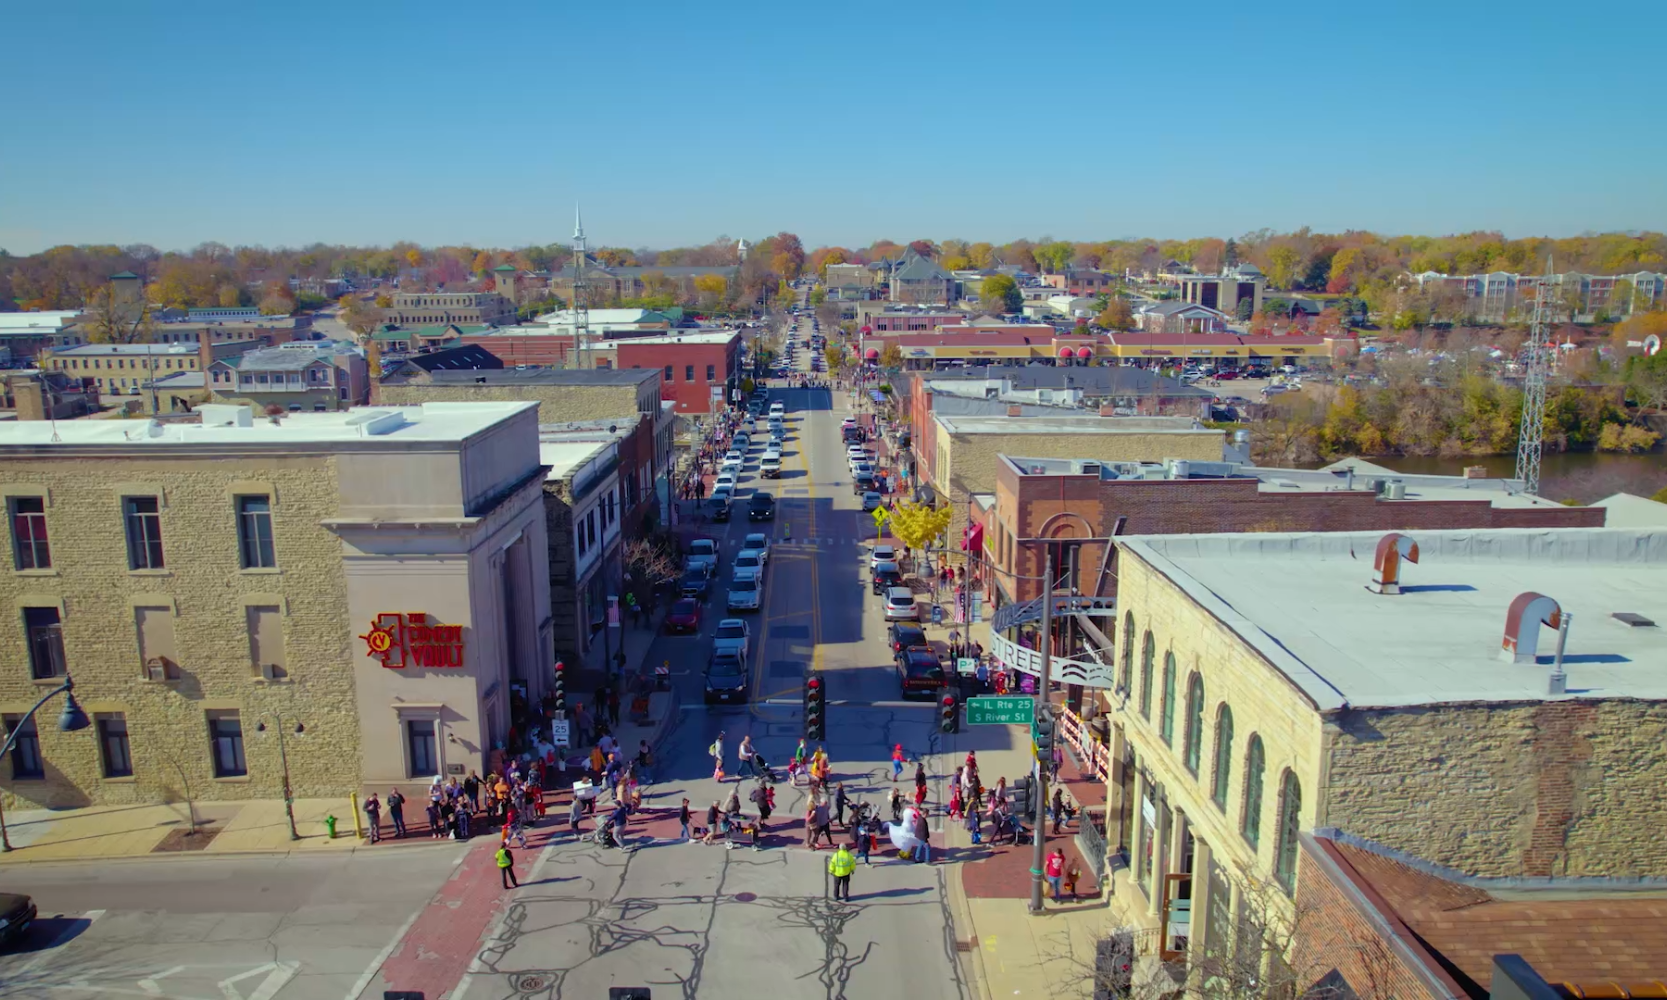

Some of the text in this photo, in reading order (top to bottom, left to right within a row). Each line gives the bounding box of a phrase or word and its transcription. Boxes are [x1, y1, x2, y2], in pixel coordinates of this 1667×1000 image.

[408, 624, 463, 643] COMEDY
[410, 644, 463, 668] VAULT
[984, 701, 1031, 709] IL Rte 25
[975, 713, 1026, 722] S River St
[555, 725, 567, 733] 25
